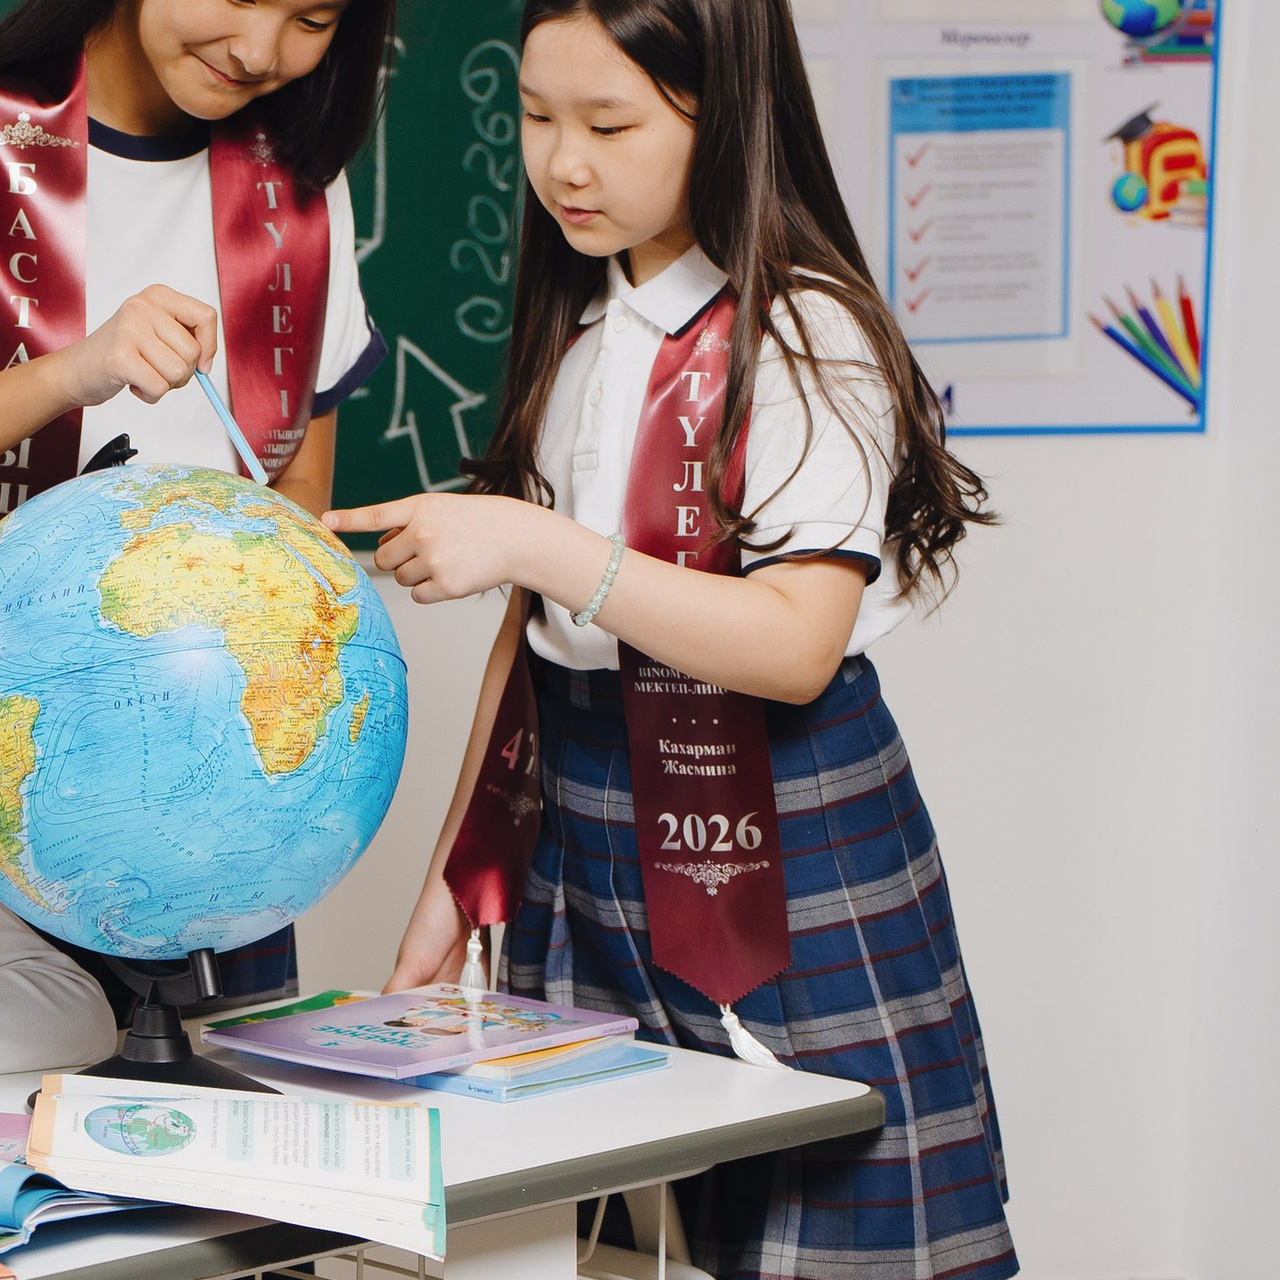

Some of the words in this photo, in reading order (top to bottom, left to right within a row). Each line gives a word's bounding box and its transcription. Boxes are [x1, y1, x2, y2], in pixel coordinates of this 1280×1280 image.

[113, 690, 170, 710] ОКЕАН
[659, 739, 737, 760] Кахарман
[662, 759, 737, 777] Жасмина
[657, 811, 763, 852] 2026
